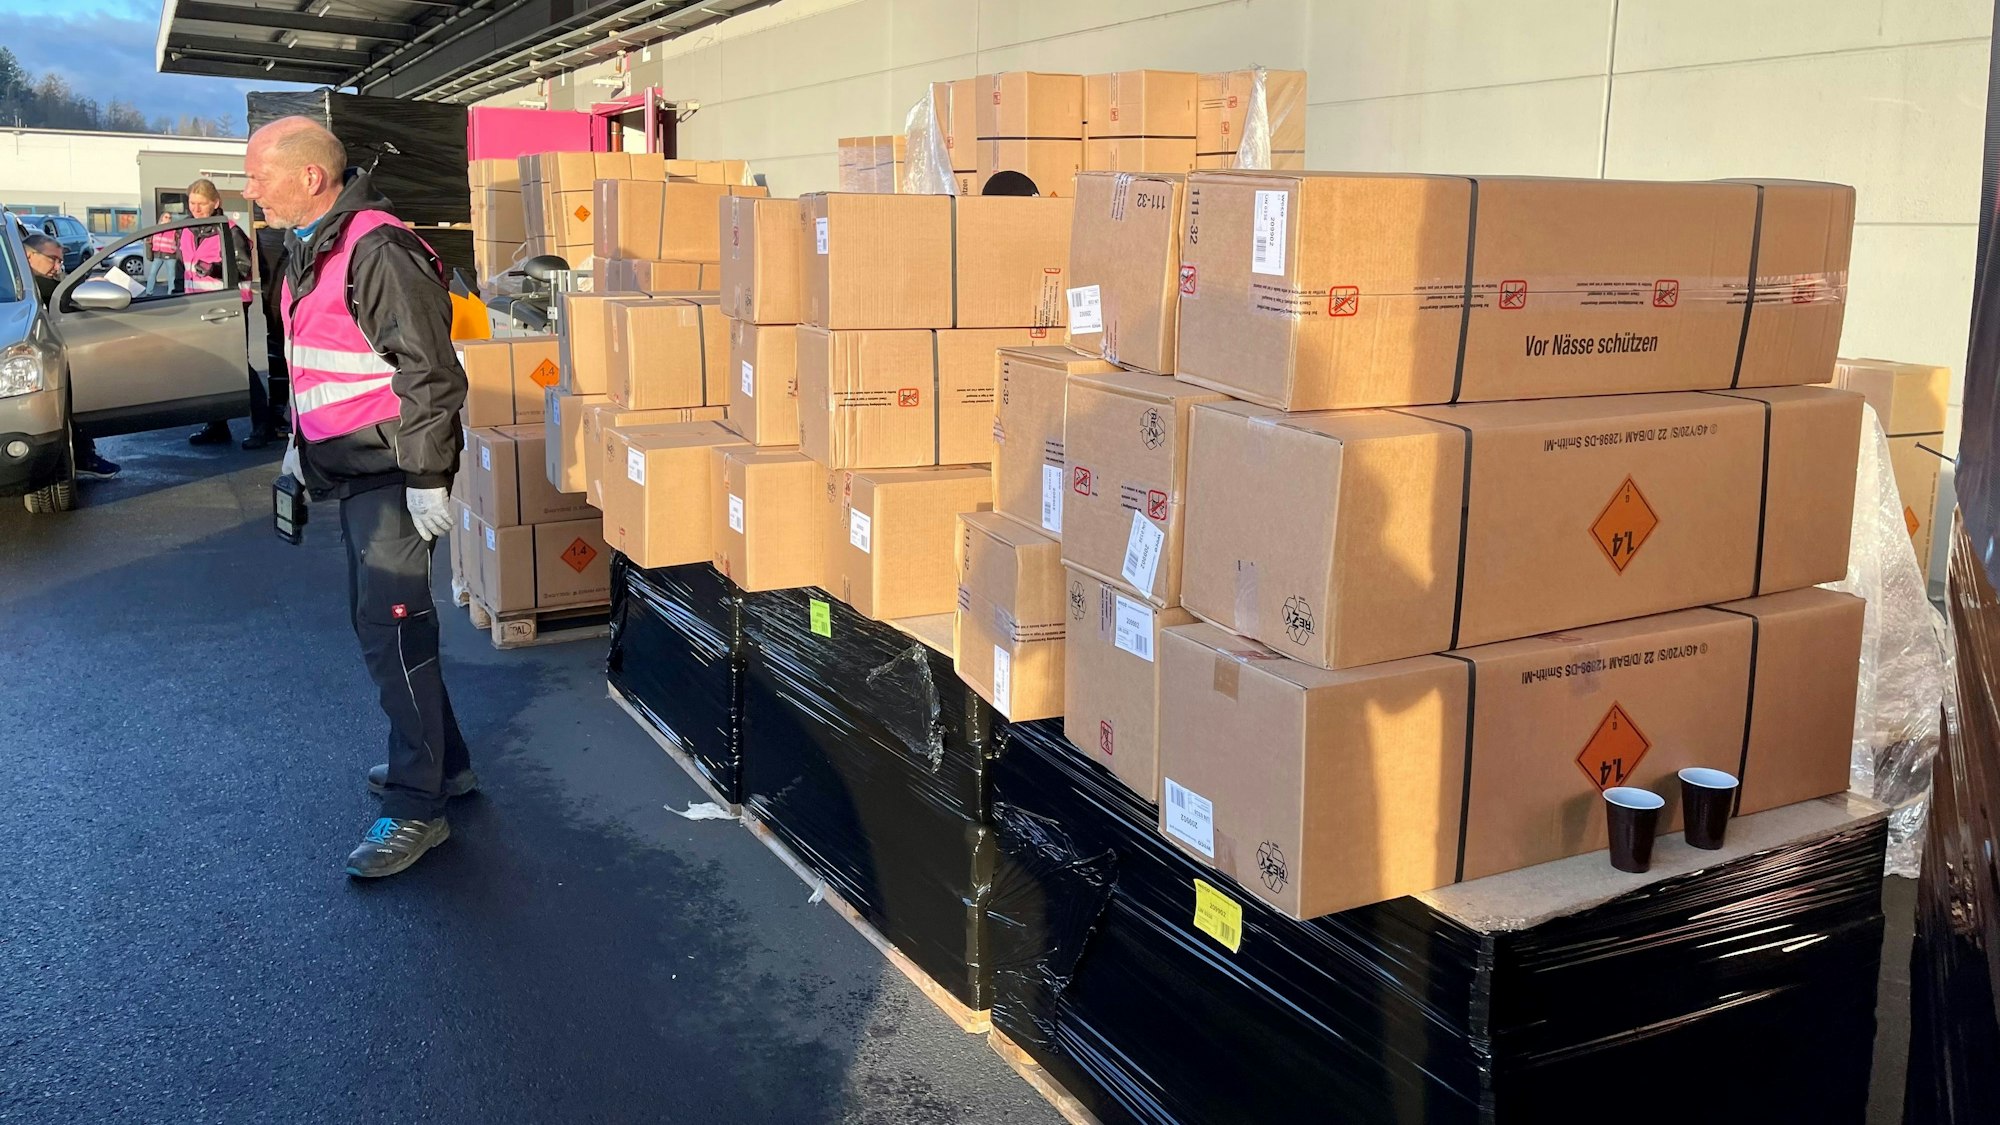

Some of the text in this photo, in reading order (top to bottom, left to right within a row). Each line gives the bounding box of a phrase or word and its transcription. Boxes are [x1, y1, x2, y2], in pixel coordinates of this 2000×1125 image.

[1137, 194, 1165, 210] 111-32
[1190, 188, 1200, 244] 111-32
[1526, 332, 1658, 356] Vor Nässe schützen
[540, 367, 554, 376] 1.4
[1625, 429, 1656, 443] /D/BAM
[1658, 428, 1667, 440] 22
[1670, 424, 1707, 438] 4G/Y20/S/
[1584, 433, 1622, 447] 12898-DS
[571, 546, 587, 556] 1.4
[1612, 531, 1634, 556] 1.4
[1644, 651, 1654, 664] 22
[1658, 645, 1698, 660] 4G/Y20/S/
[1565, 659, 1606, 676] 12898-DS
[1609, 652, 1641, 669] /D/BAM
[1600, 758, 1624, 785] 1.4
